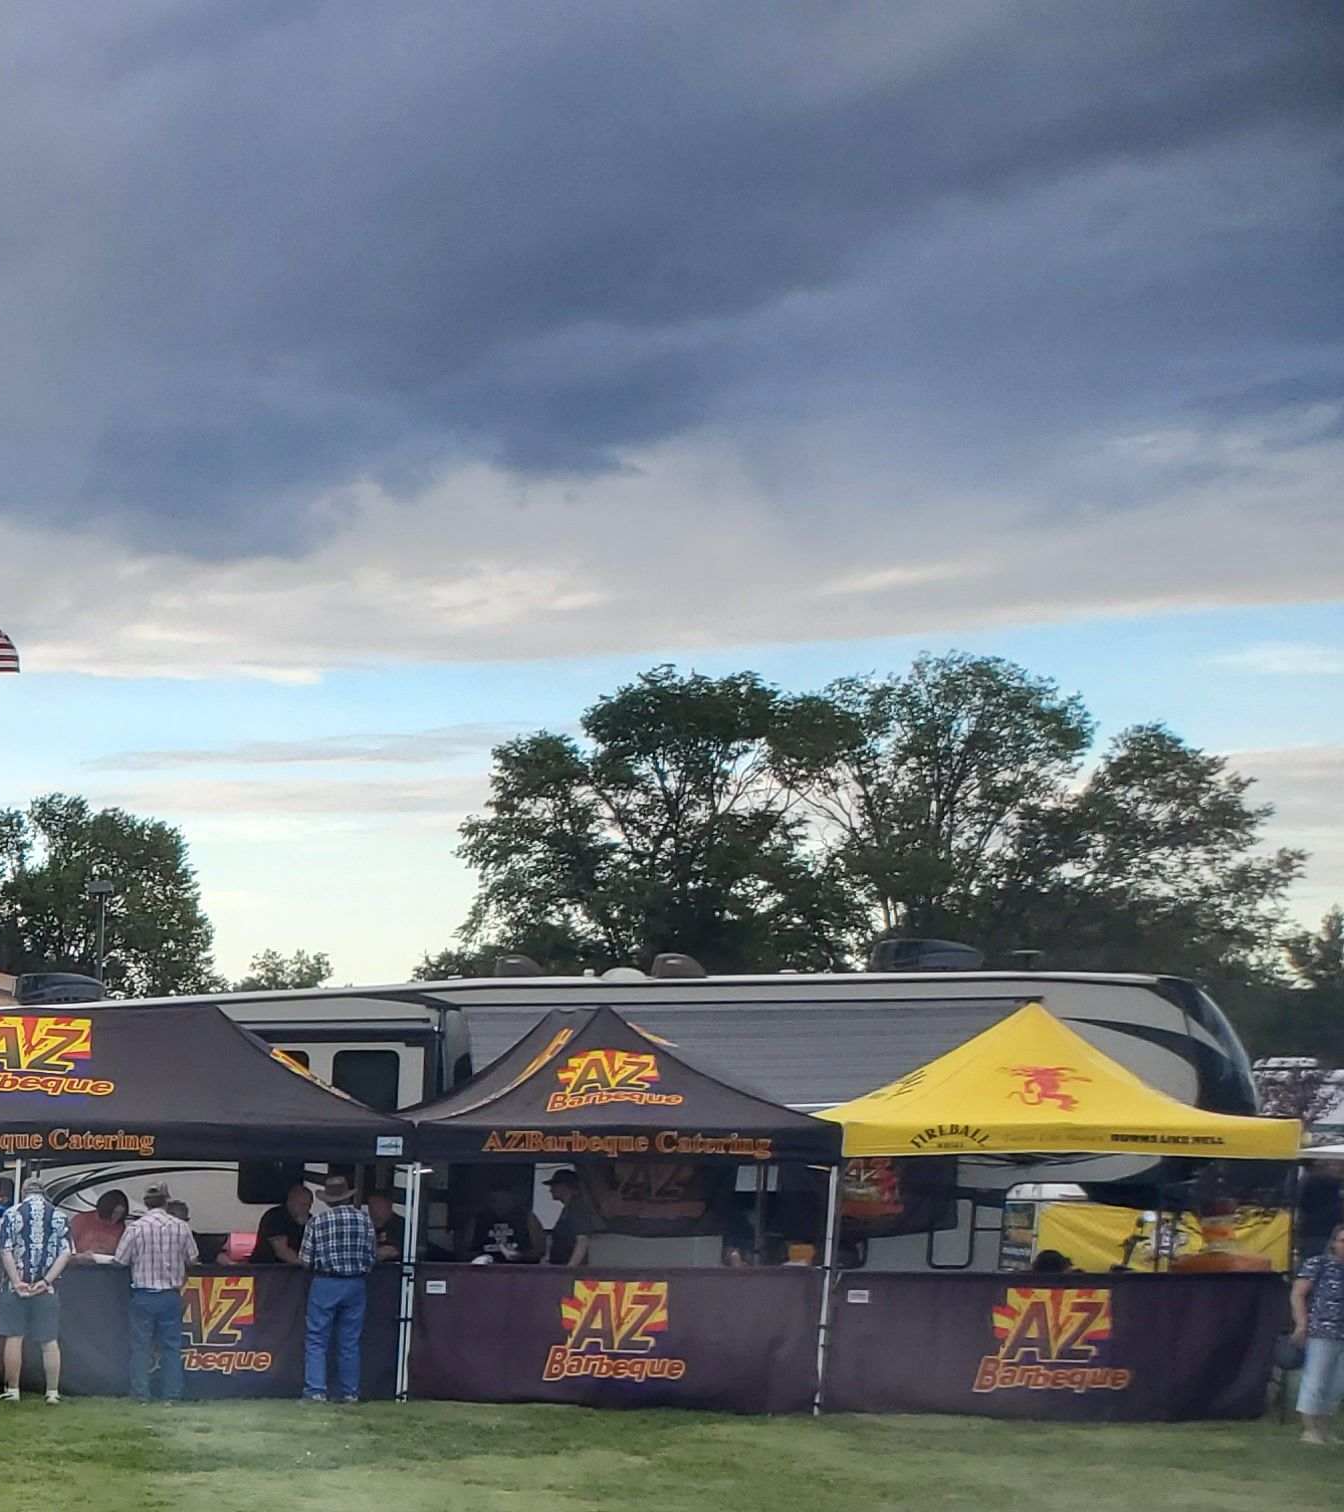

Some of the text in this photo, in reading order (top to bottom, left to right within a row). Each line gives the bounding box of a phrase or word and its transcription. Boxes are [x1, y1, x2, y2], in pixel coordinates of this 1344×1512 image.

[568, 1054, 653, 1094] AZ
[546, 1091, 684, 1112] Barbeque
[48, 1128, 155, 1156] Catering
[482, 1131, 772, 1159] AZBarbeque Catering
[567, 1291, 663, 1353] AZ
[999, 1299, 1107, 1363] AZ
[182, 1349, 272, 1374] beque
[543, 1345, 686, 1382] Barbeque
[973, 1355, 1133, 1393] Barbeque
